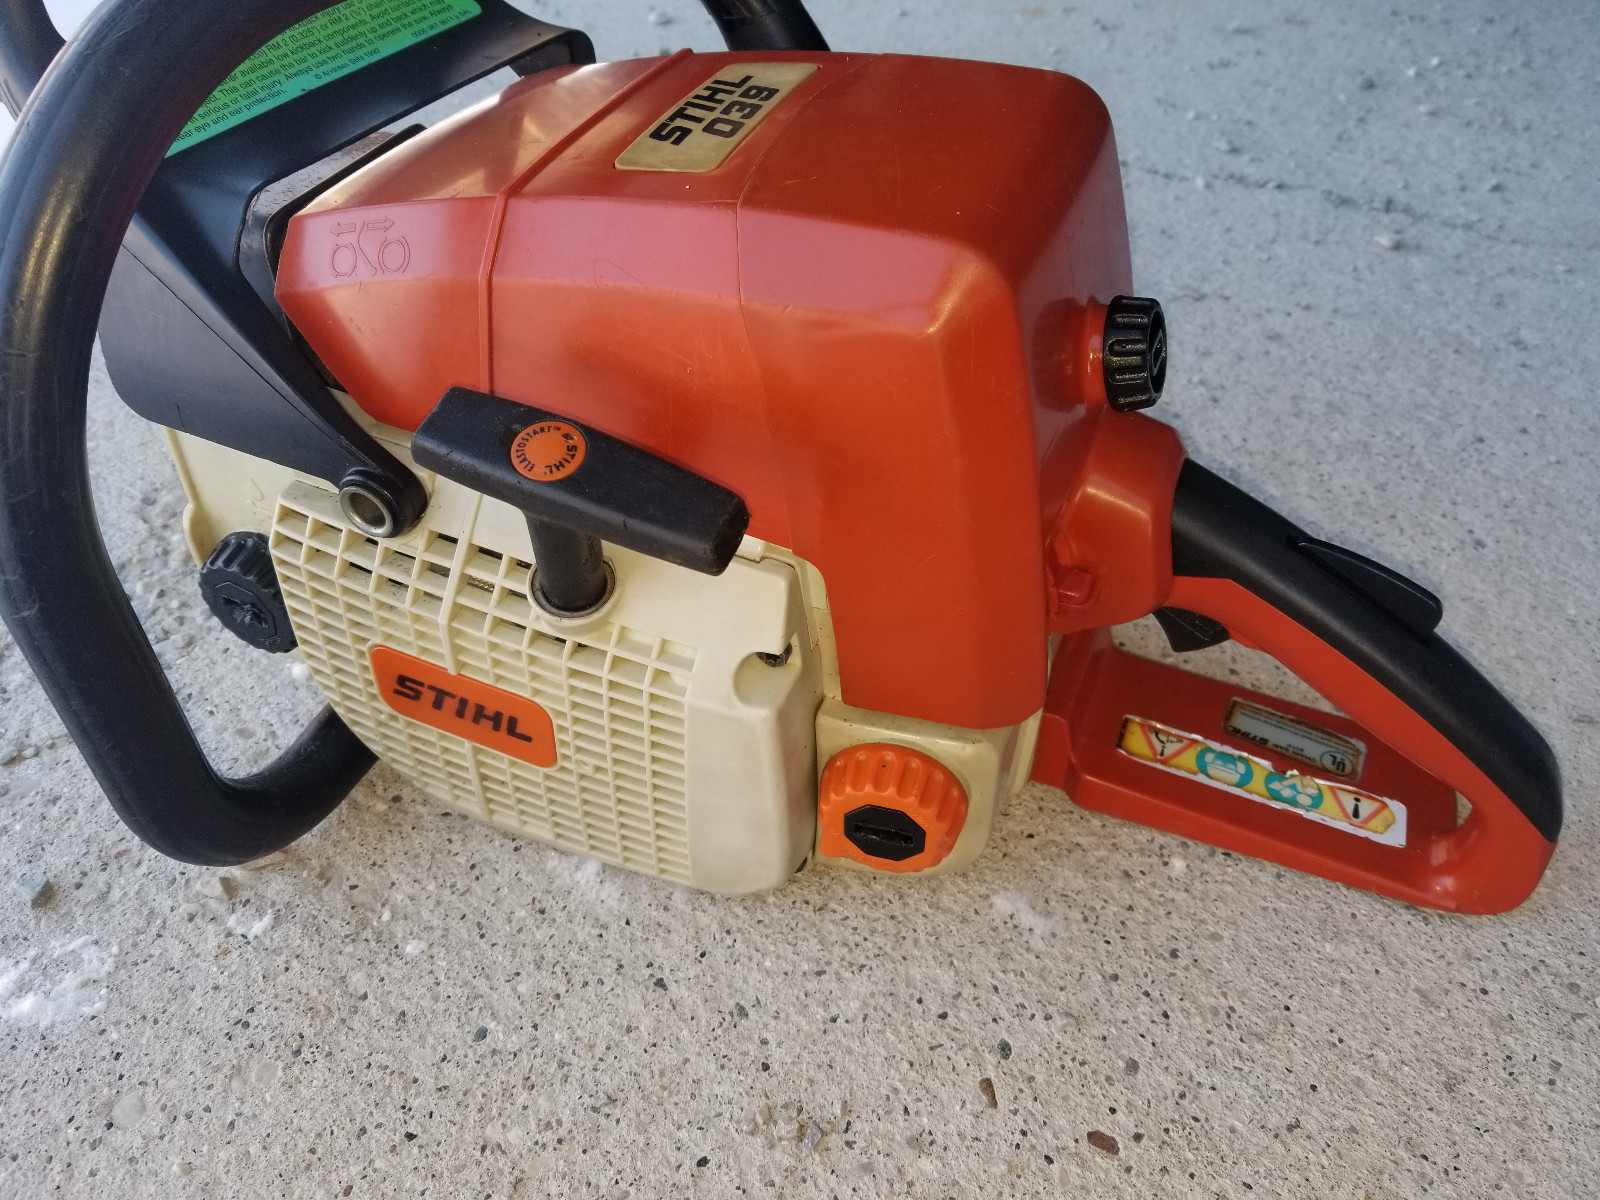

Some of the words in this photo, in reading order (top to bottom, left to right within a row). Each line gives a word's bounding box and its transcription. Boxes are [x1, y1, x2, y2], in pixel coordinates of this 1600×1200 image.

[342, 0, 355, 10] use
[218, 84, 239, 98] This
[239, 78, 256, 90] can
[256, 67, 281, 83] cause
[279, 60, 295, 72] the
[293, 54, 309, 66] bar
[308, 51, 318, 60] to
[316, 43, 334, 56] kick
[333, 29, 367, 50] suddenly
[367, 26, 378, 35] up
[377, 17, 392, 30] and
[390, 10, 410, 24] back
[408, 2, 430, 16] which
[239, 57, 275, 78] available
[273, 50, 290, 63] low
[288, 33, 324, 57] kickback
[323, 17, 368, 43] components.
[368, 6, 390, 22] Avoid
[265, 40, 282, 54] RM
[281, 38, 289, 47] 2
[320, 23, 329, 31] or
[327, 14, 343, 27] RM
[342, 13, 350, 21] 2
[198, 101, 230, 120] serious
[230, 97, 240, 105] or
[239, 87, 259, 101] fatal
[257, 77, 284, 93] injury.
[283, 64, 313, 82] Always
[312, 58, 328, 69] use
[326, 51, 343, 63] two
[341, 41, 365, 56] hands
[364, 37, 374, 46] to
[374, 26, 402, 42] operate
[400, 20, 413, 30] the
[413, 14, 430, 25] saw.
[428, 3, 453, 18] Always
[194, 122, 211, 133] eye
[211, 112, 228, 125] and
[229, 106, 243, 117] ear
[244, 87, 287, 111] protection.
[649, 75, 754, 145] STIHL
[702, 86, 779, 138] 039
[516, 426, 552, 472] ELASTOSTART
[545, 445, 577, 474] STIHL
[393, 675, 532, 742] STIHL
